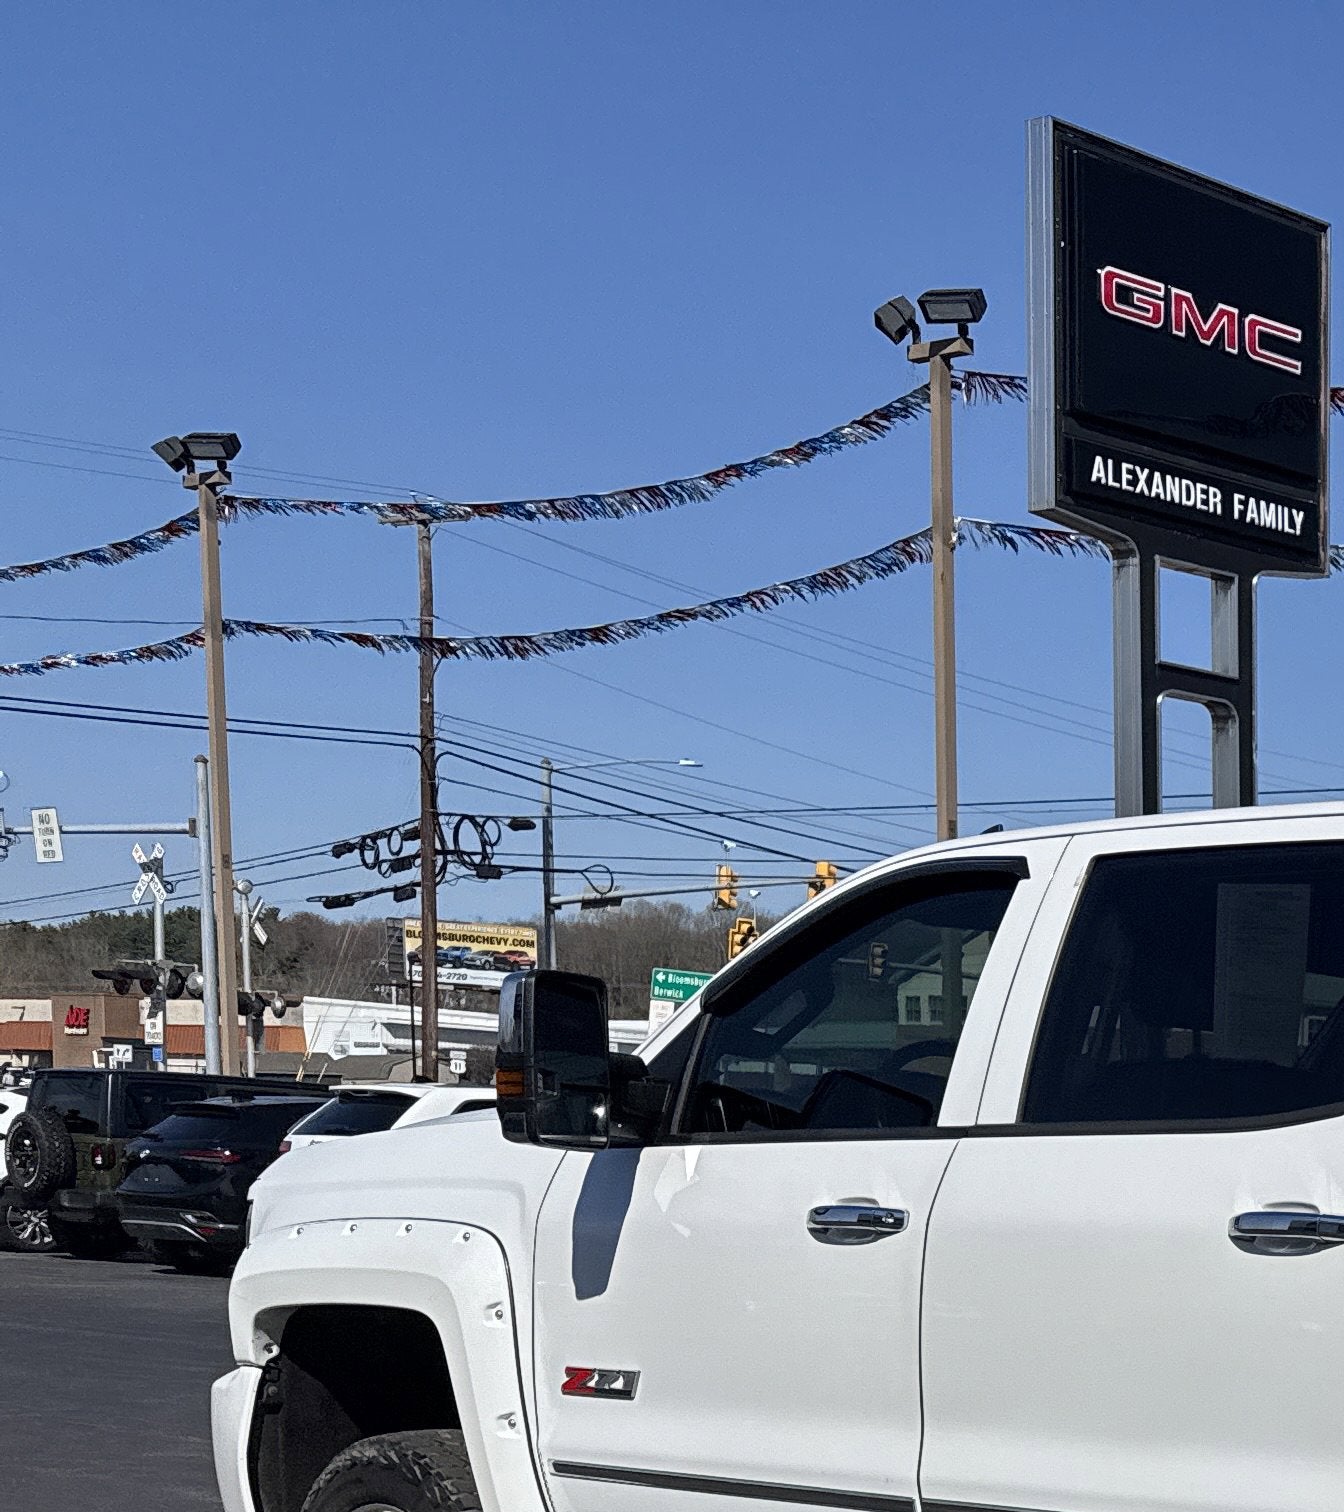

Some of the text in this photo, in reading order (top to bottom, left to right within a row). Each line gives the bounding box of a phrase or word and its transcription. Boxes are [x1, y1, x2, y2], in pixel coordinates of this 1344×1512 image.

[1101, 265, 1302, 375] GMC
[1091, 455, 1304, 536] ALEXANDER FAMILY
[38, 813, 51, 825] NO
[654, 986, 684, 998] Berwick
[667, 973, 710, 987] Bloomsbur
[561, 1366, 641, 1401] Z71
